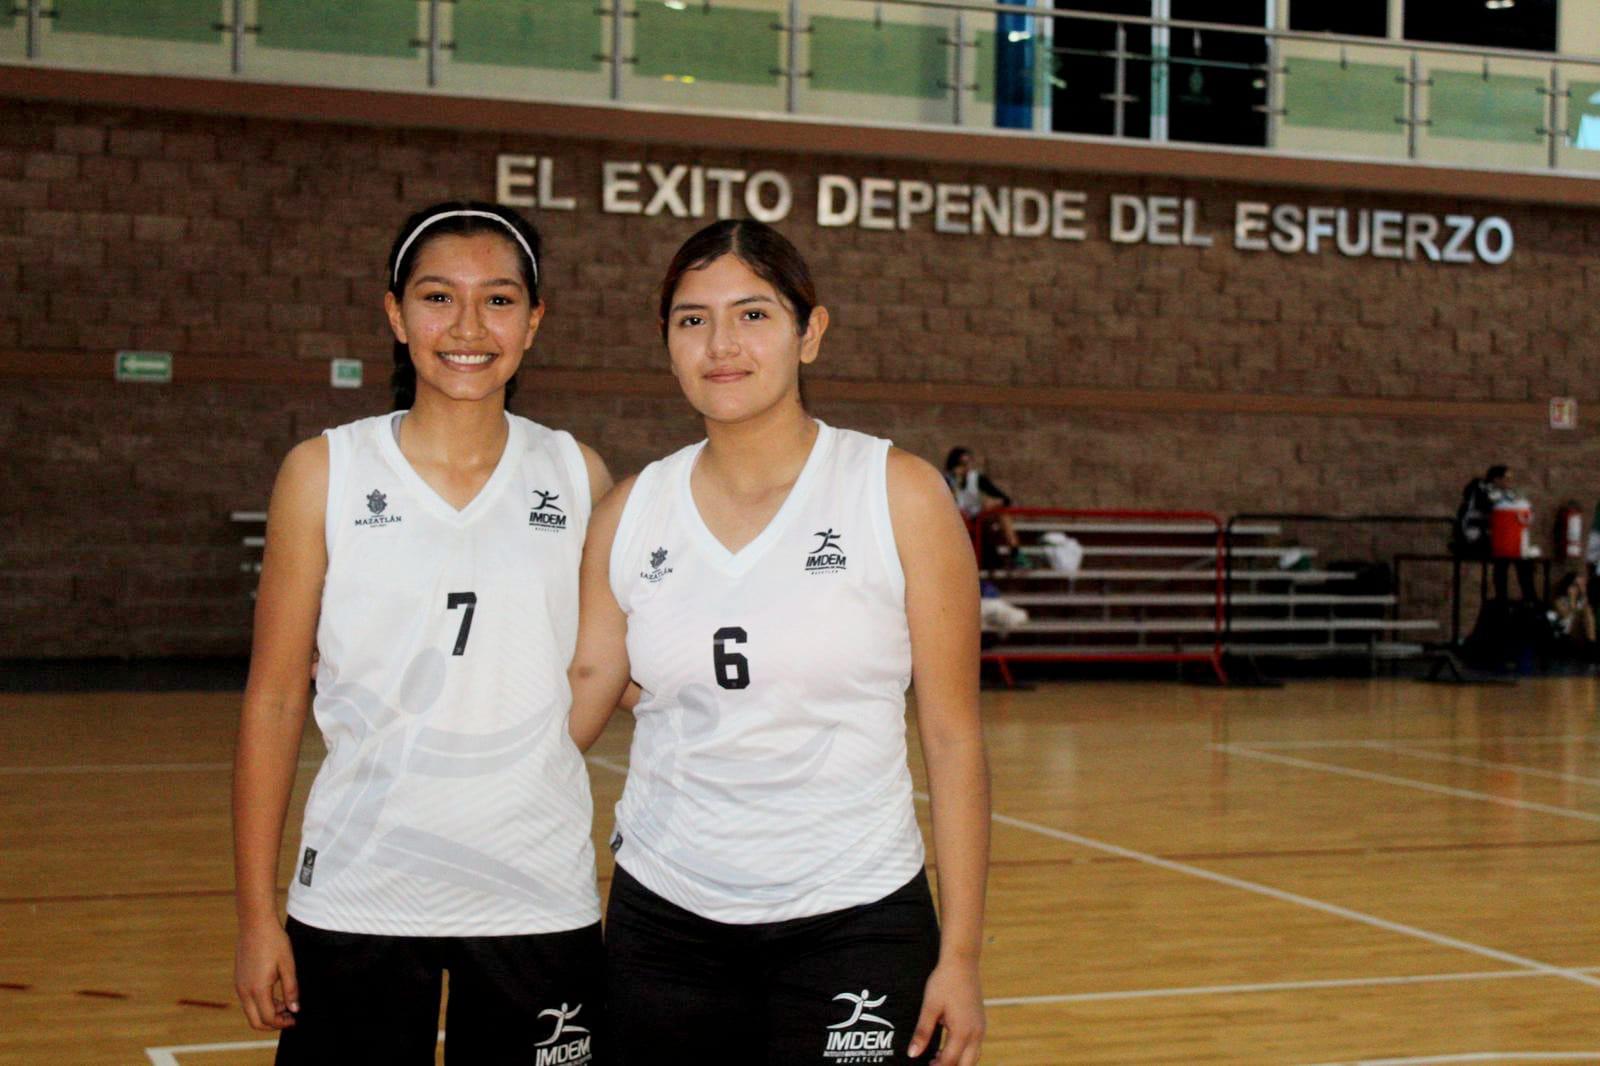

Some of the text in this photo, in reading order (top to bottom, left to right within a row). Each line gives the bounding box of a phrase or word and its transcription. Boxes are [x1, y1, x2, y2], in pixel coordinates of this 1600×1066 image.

[496, 153, 1514, 264] EL EXITO DEPENDE DEL ESFUERZO
[529, 511, 567, 526] IMDEM
[805, 553, 847, 568] IMDEM
[446, 591, 477, 656] 7
[713, 626, 751, 689] 6
[535, 1035, 592, 1066] IMDEM
[825, 1030, 895, 1050] IMDEM
